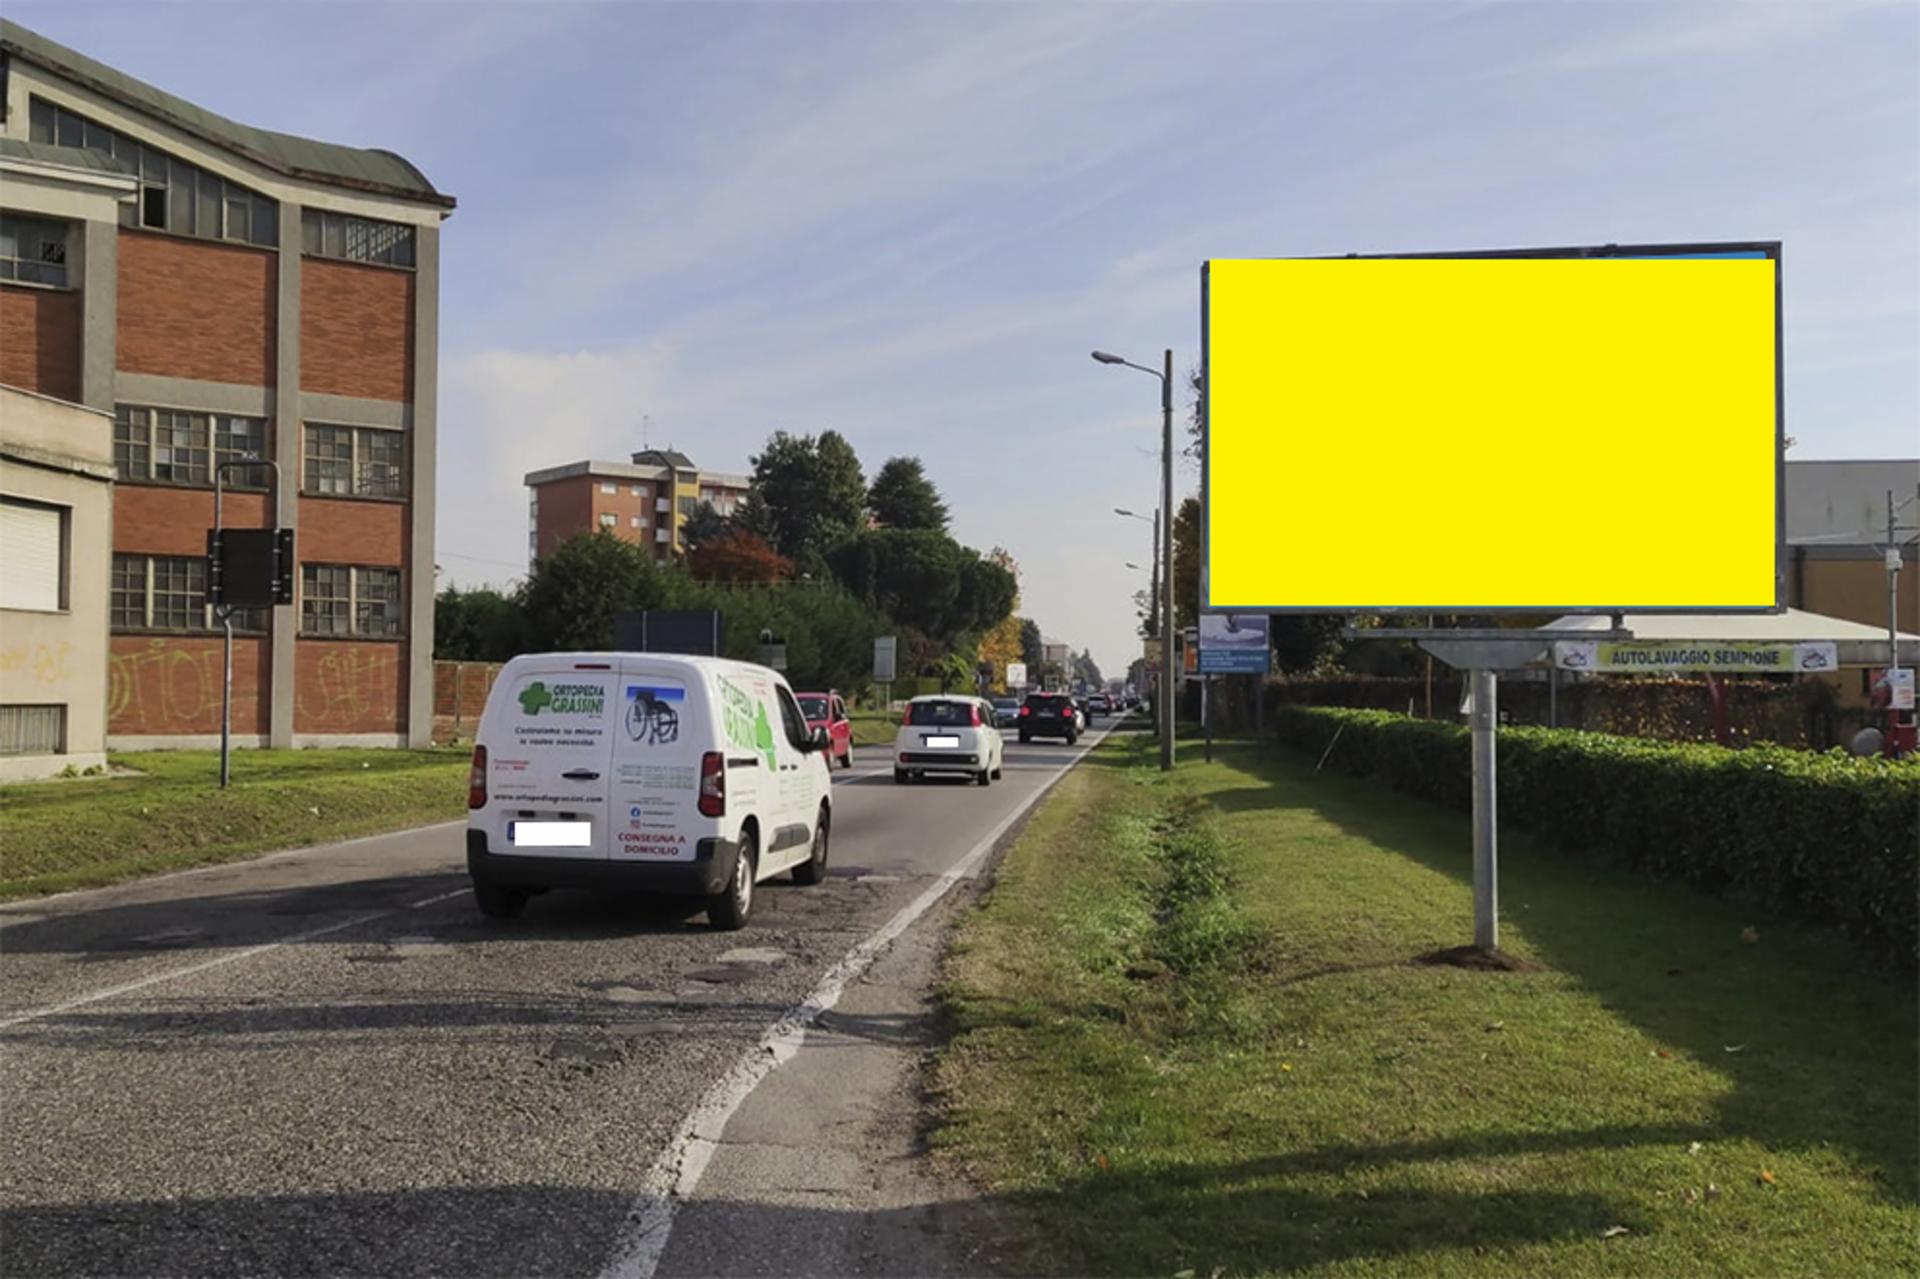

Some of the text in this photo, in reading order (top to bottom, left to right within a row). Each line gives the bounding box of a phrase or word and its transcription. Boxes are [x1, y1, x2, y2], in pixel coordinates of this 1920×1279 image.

[1611, 650, 1779, 665] AUTOLAVAGGIO SEMPIONE
[553, 684, 605, 697] ORTOPEDIA
[551, 698, 605, 714] GRASSINI
[618, 832, 686, 844] CONSEGNA A
[624, 845, 679, 856] DOMICILIO
